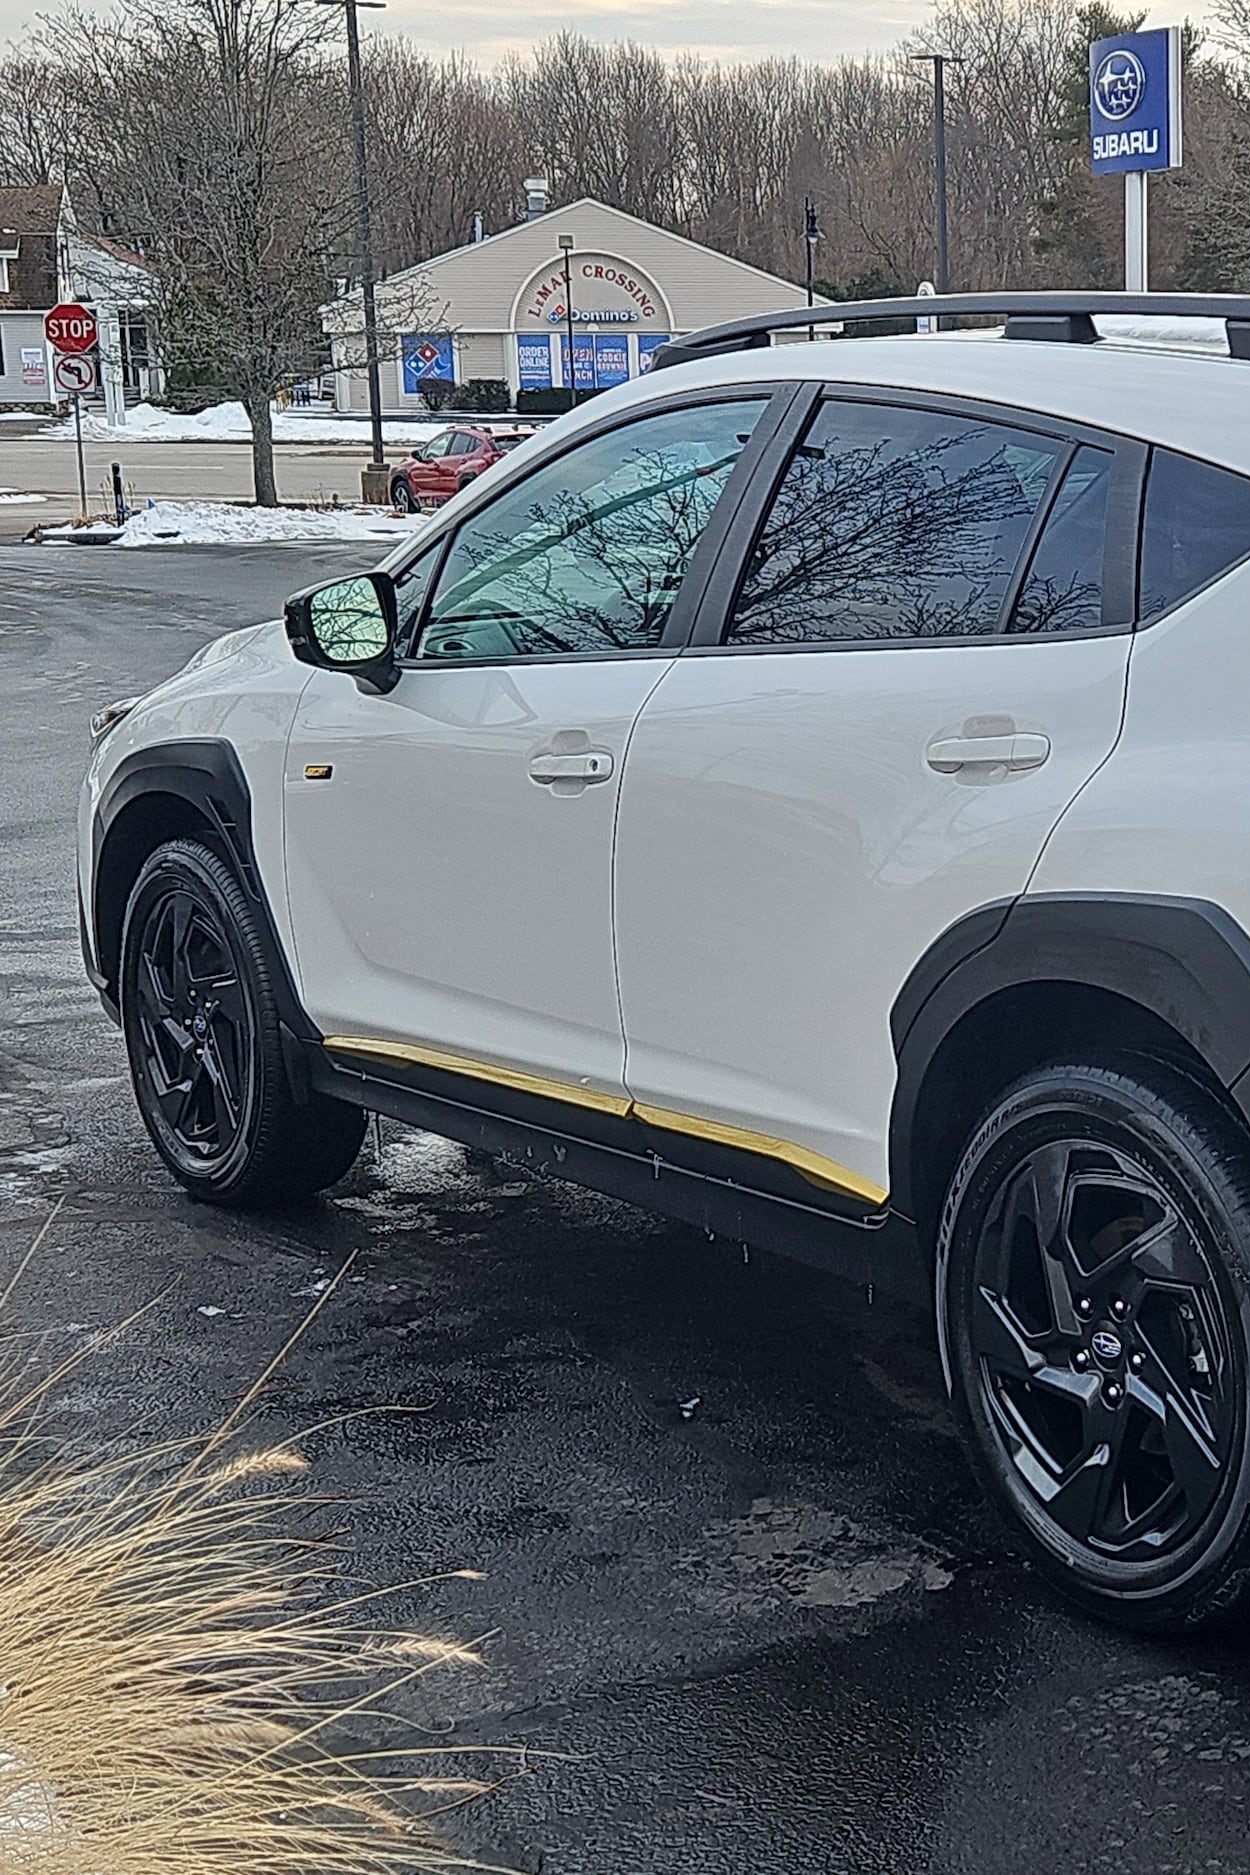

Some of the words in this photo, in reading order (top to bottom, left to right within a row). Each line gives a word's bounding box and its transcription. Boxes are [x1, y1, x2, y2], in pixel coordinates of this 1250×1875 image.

[1093, 129, 1158, 160] SUBARU
[582, 265, 655, 318] CROSSING
[570, 308, 638, 321] Domino's
[48, 319, 94, 338] STOP
[519, 346, 549, 358] ORDER
[563, 348, 593, 362] OPEN
[598, 352, 627, 363] COOKIE
[520, 357, 549, 368] ONLINE
